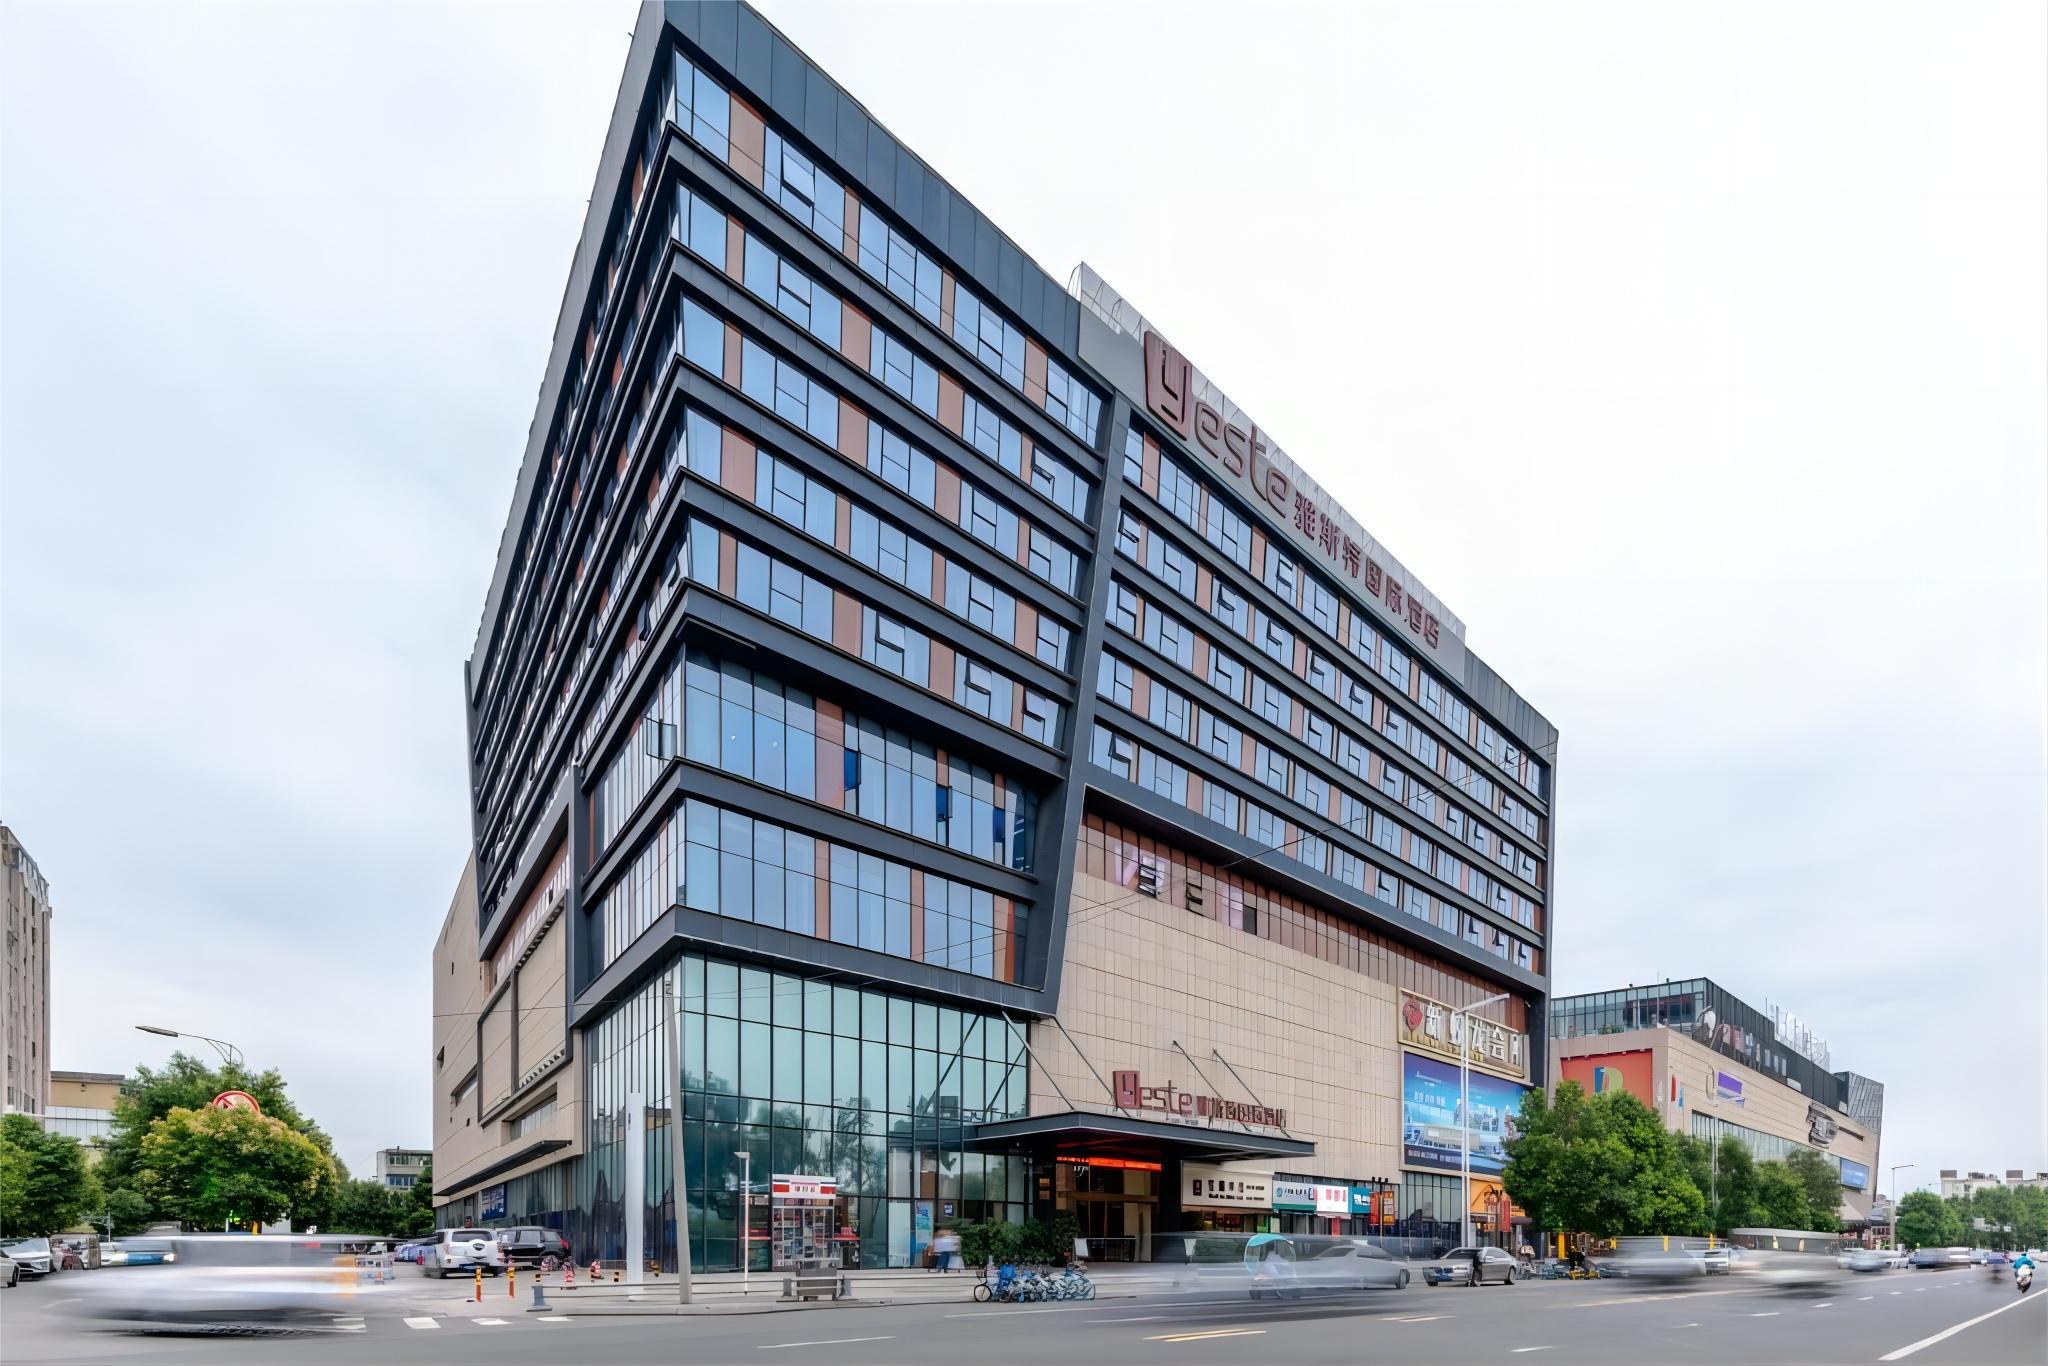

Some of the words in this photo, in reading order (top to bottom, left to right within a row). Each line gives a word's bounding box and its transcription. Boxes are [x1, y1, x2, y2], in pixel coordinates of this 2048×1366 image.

[1294, 490, 1440, 650] 雅斯特国际酒店
